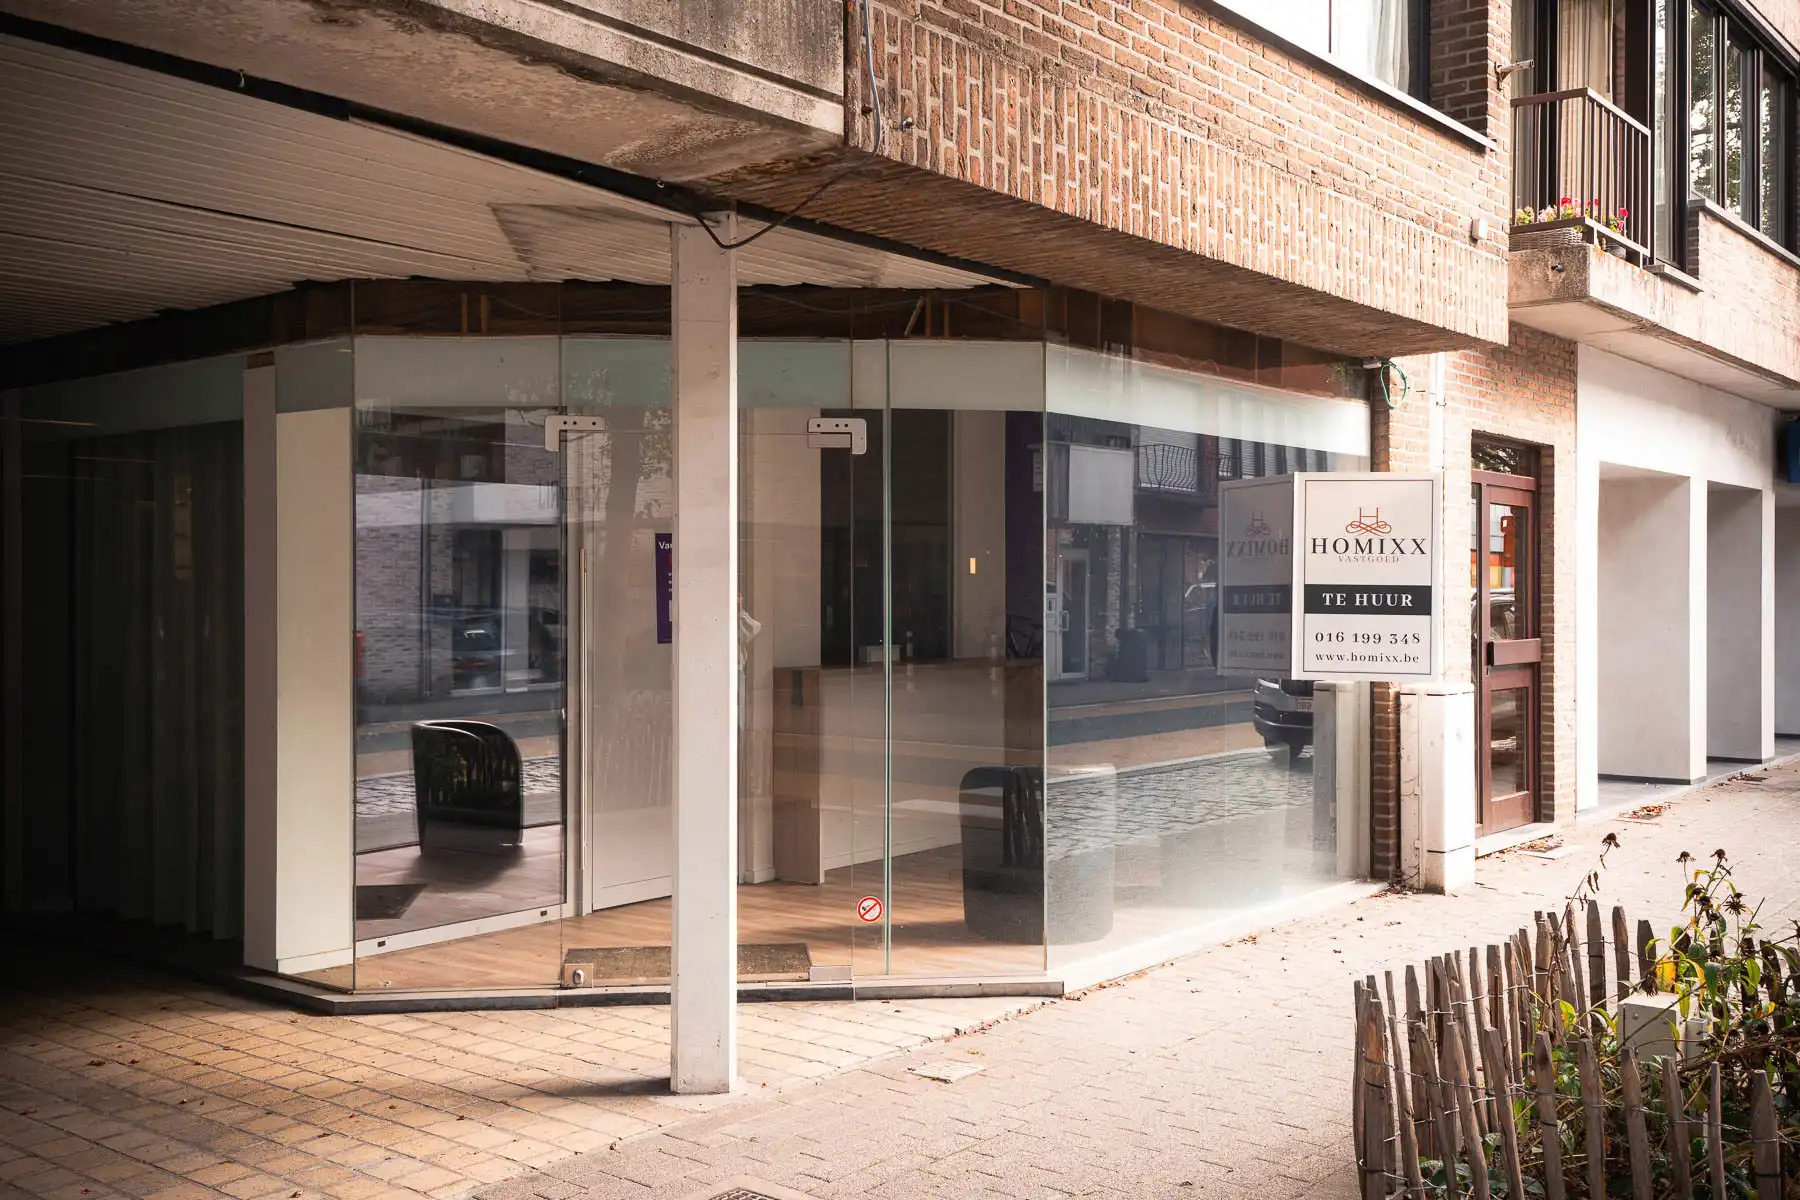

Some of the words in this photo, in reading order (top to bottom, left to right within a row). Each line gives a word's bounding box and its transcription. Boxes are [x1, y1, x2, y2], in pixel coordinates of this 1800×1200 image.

[1311, 537, 1427, 555] HOMIXX
[1338, 555, 1400, 563] VASTGOED
[1322, 592, 1347, 606] TE
[1355, 593, 1413, 607] HUUR
[1315, 631, 1345, 643] 016
[1353, 632, 1382, 644] 199
[1389, 632, 1421, 645] 348
[1315, 652, 1419, 663] www.homixx.be
